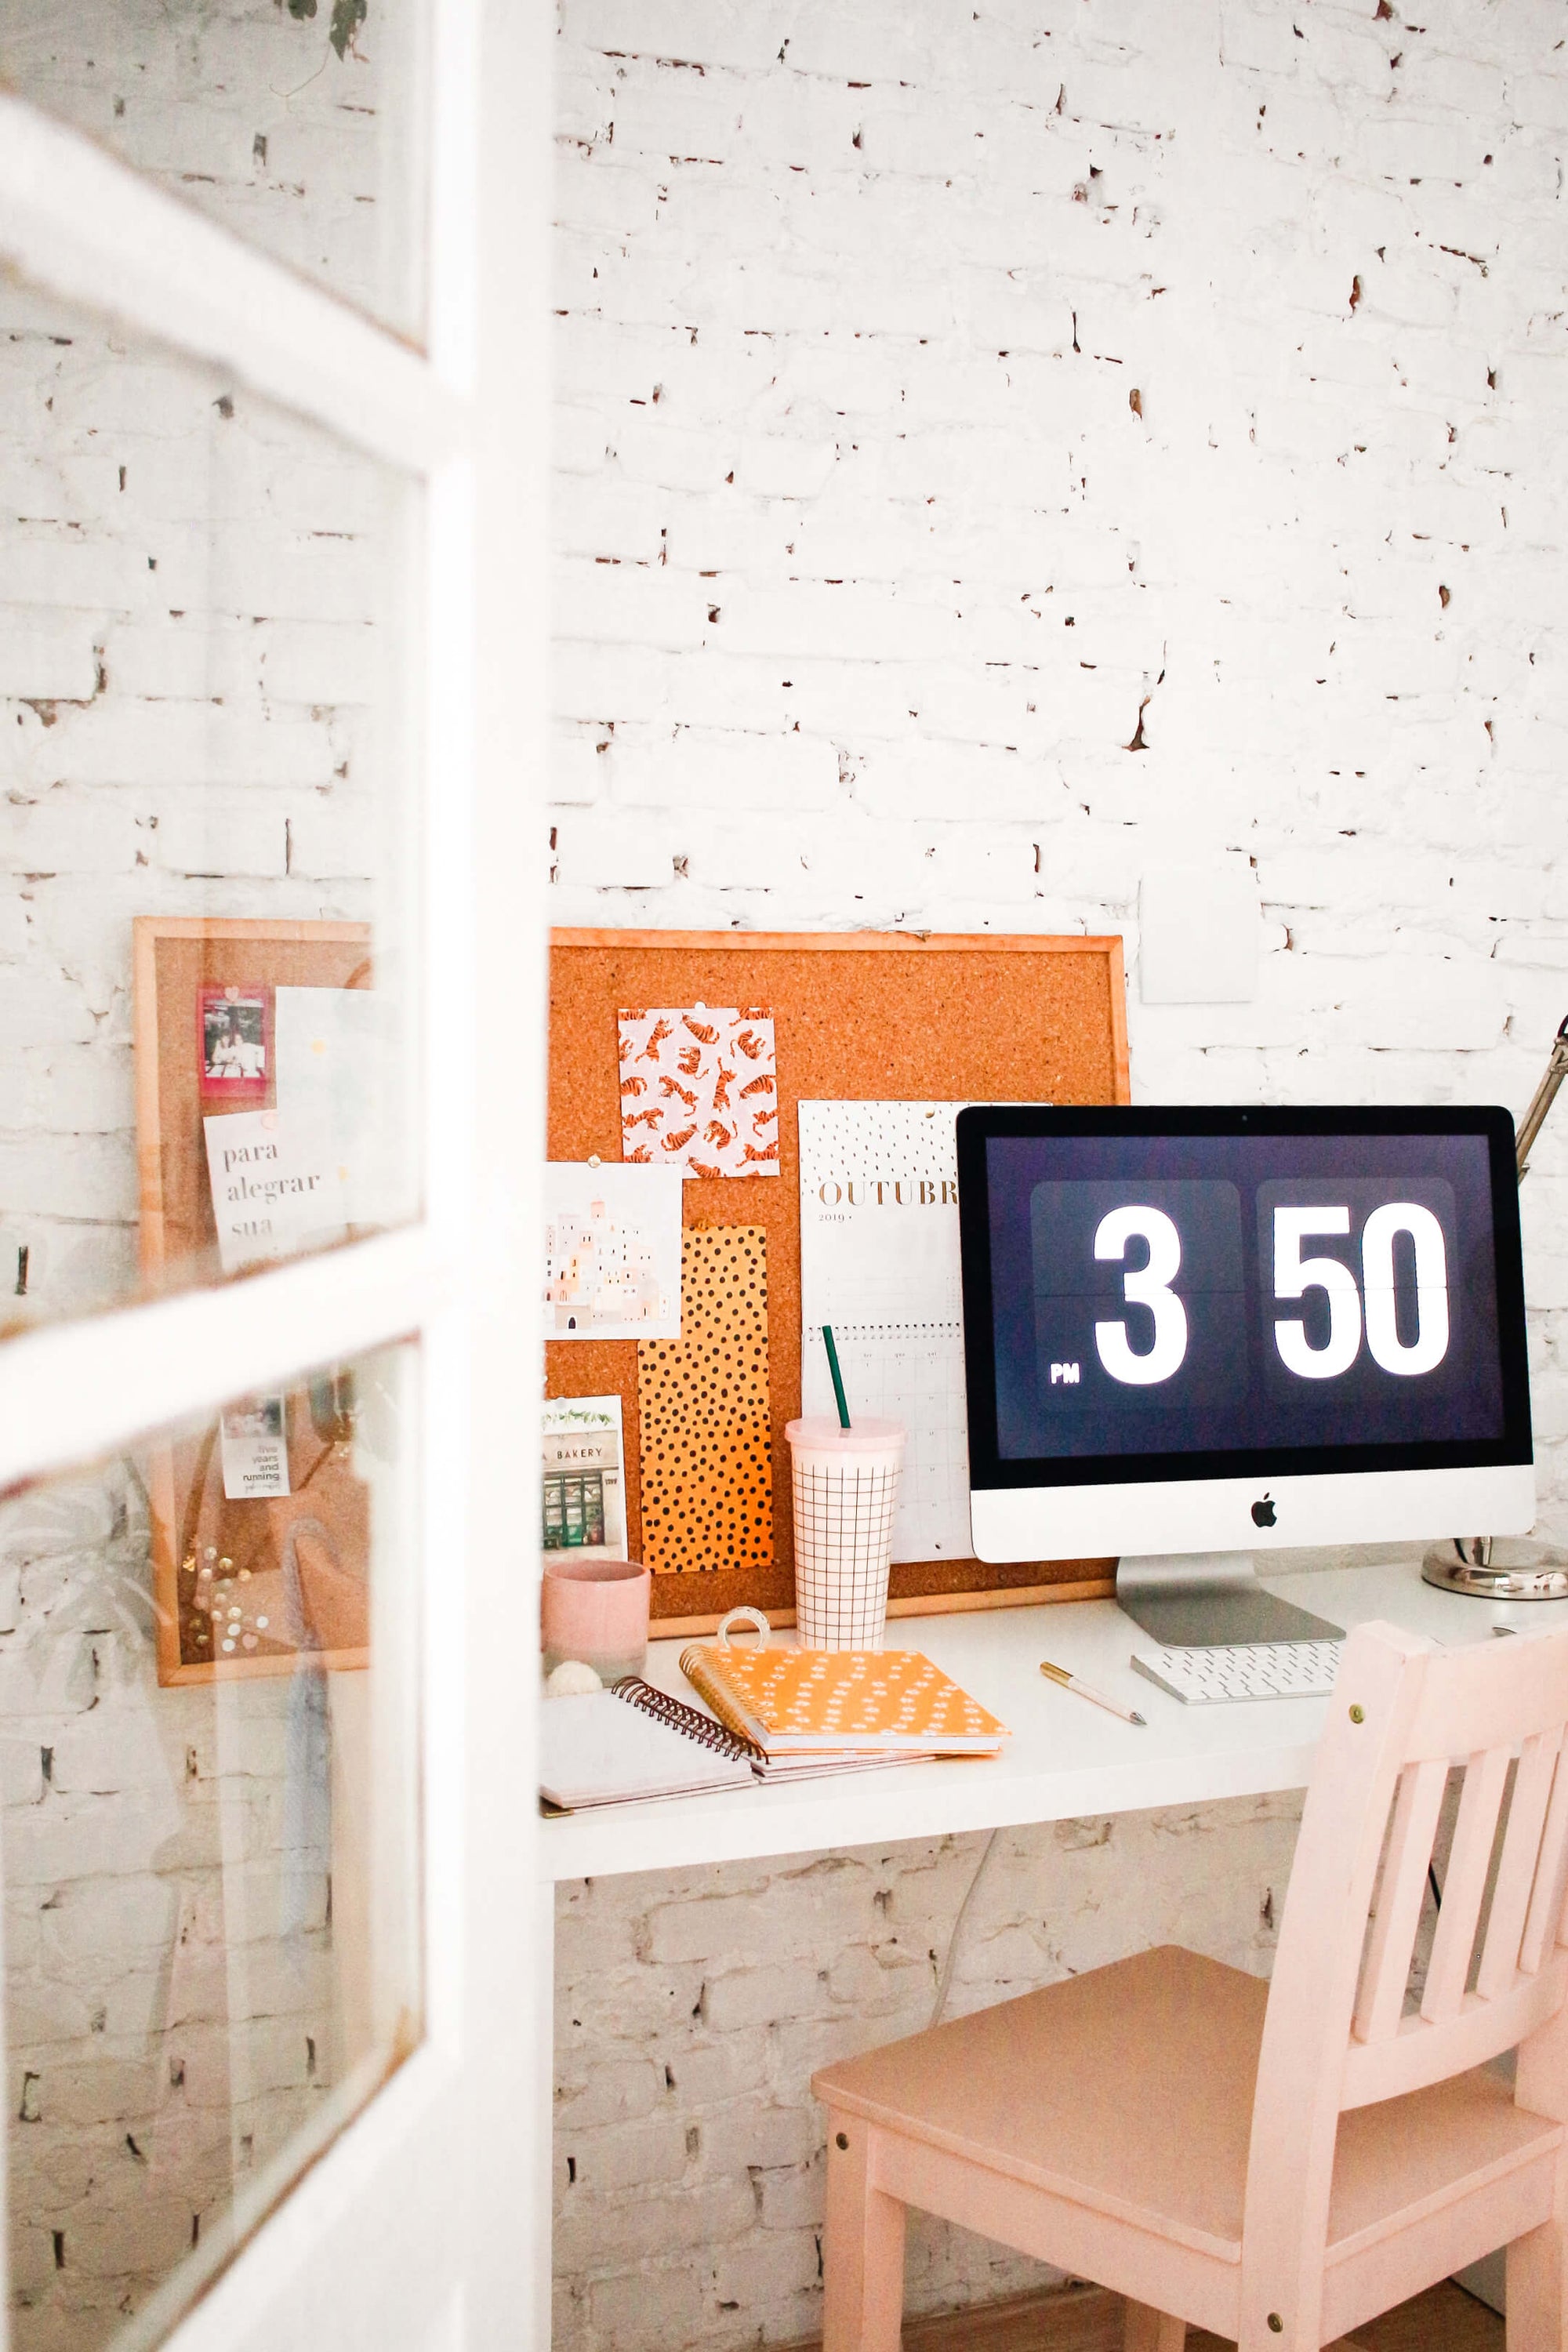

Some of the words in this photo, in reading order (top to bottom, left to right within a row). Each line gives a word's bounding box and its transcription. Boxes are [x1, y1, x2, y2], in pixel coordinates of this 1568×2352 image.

[223, 1144, 278, 1173] para
[227, 1175, 320, 1204] alegrar
[818, 1214, 845, 1223] 2019
[232, 1219, 273, 1236] sua
[1094, 1205, 1188, 1385] 3
[1273, 1202, 1450, 1379] 50
[1051, 1363, 1080, 1384] PM
[252, 1455, 278, 1464] years
[557, 1448, 601, 1459] BAKERY
[260, 1462, 279, 1472] and
[243, 1472, 280, 1481] running
